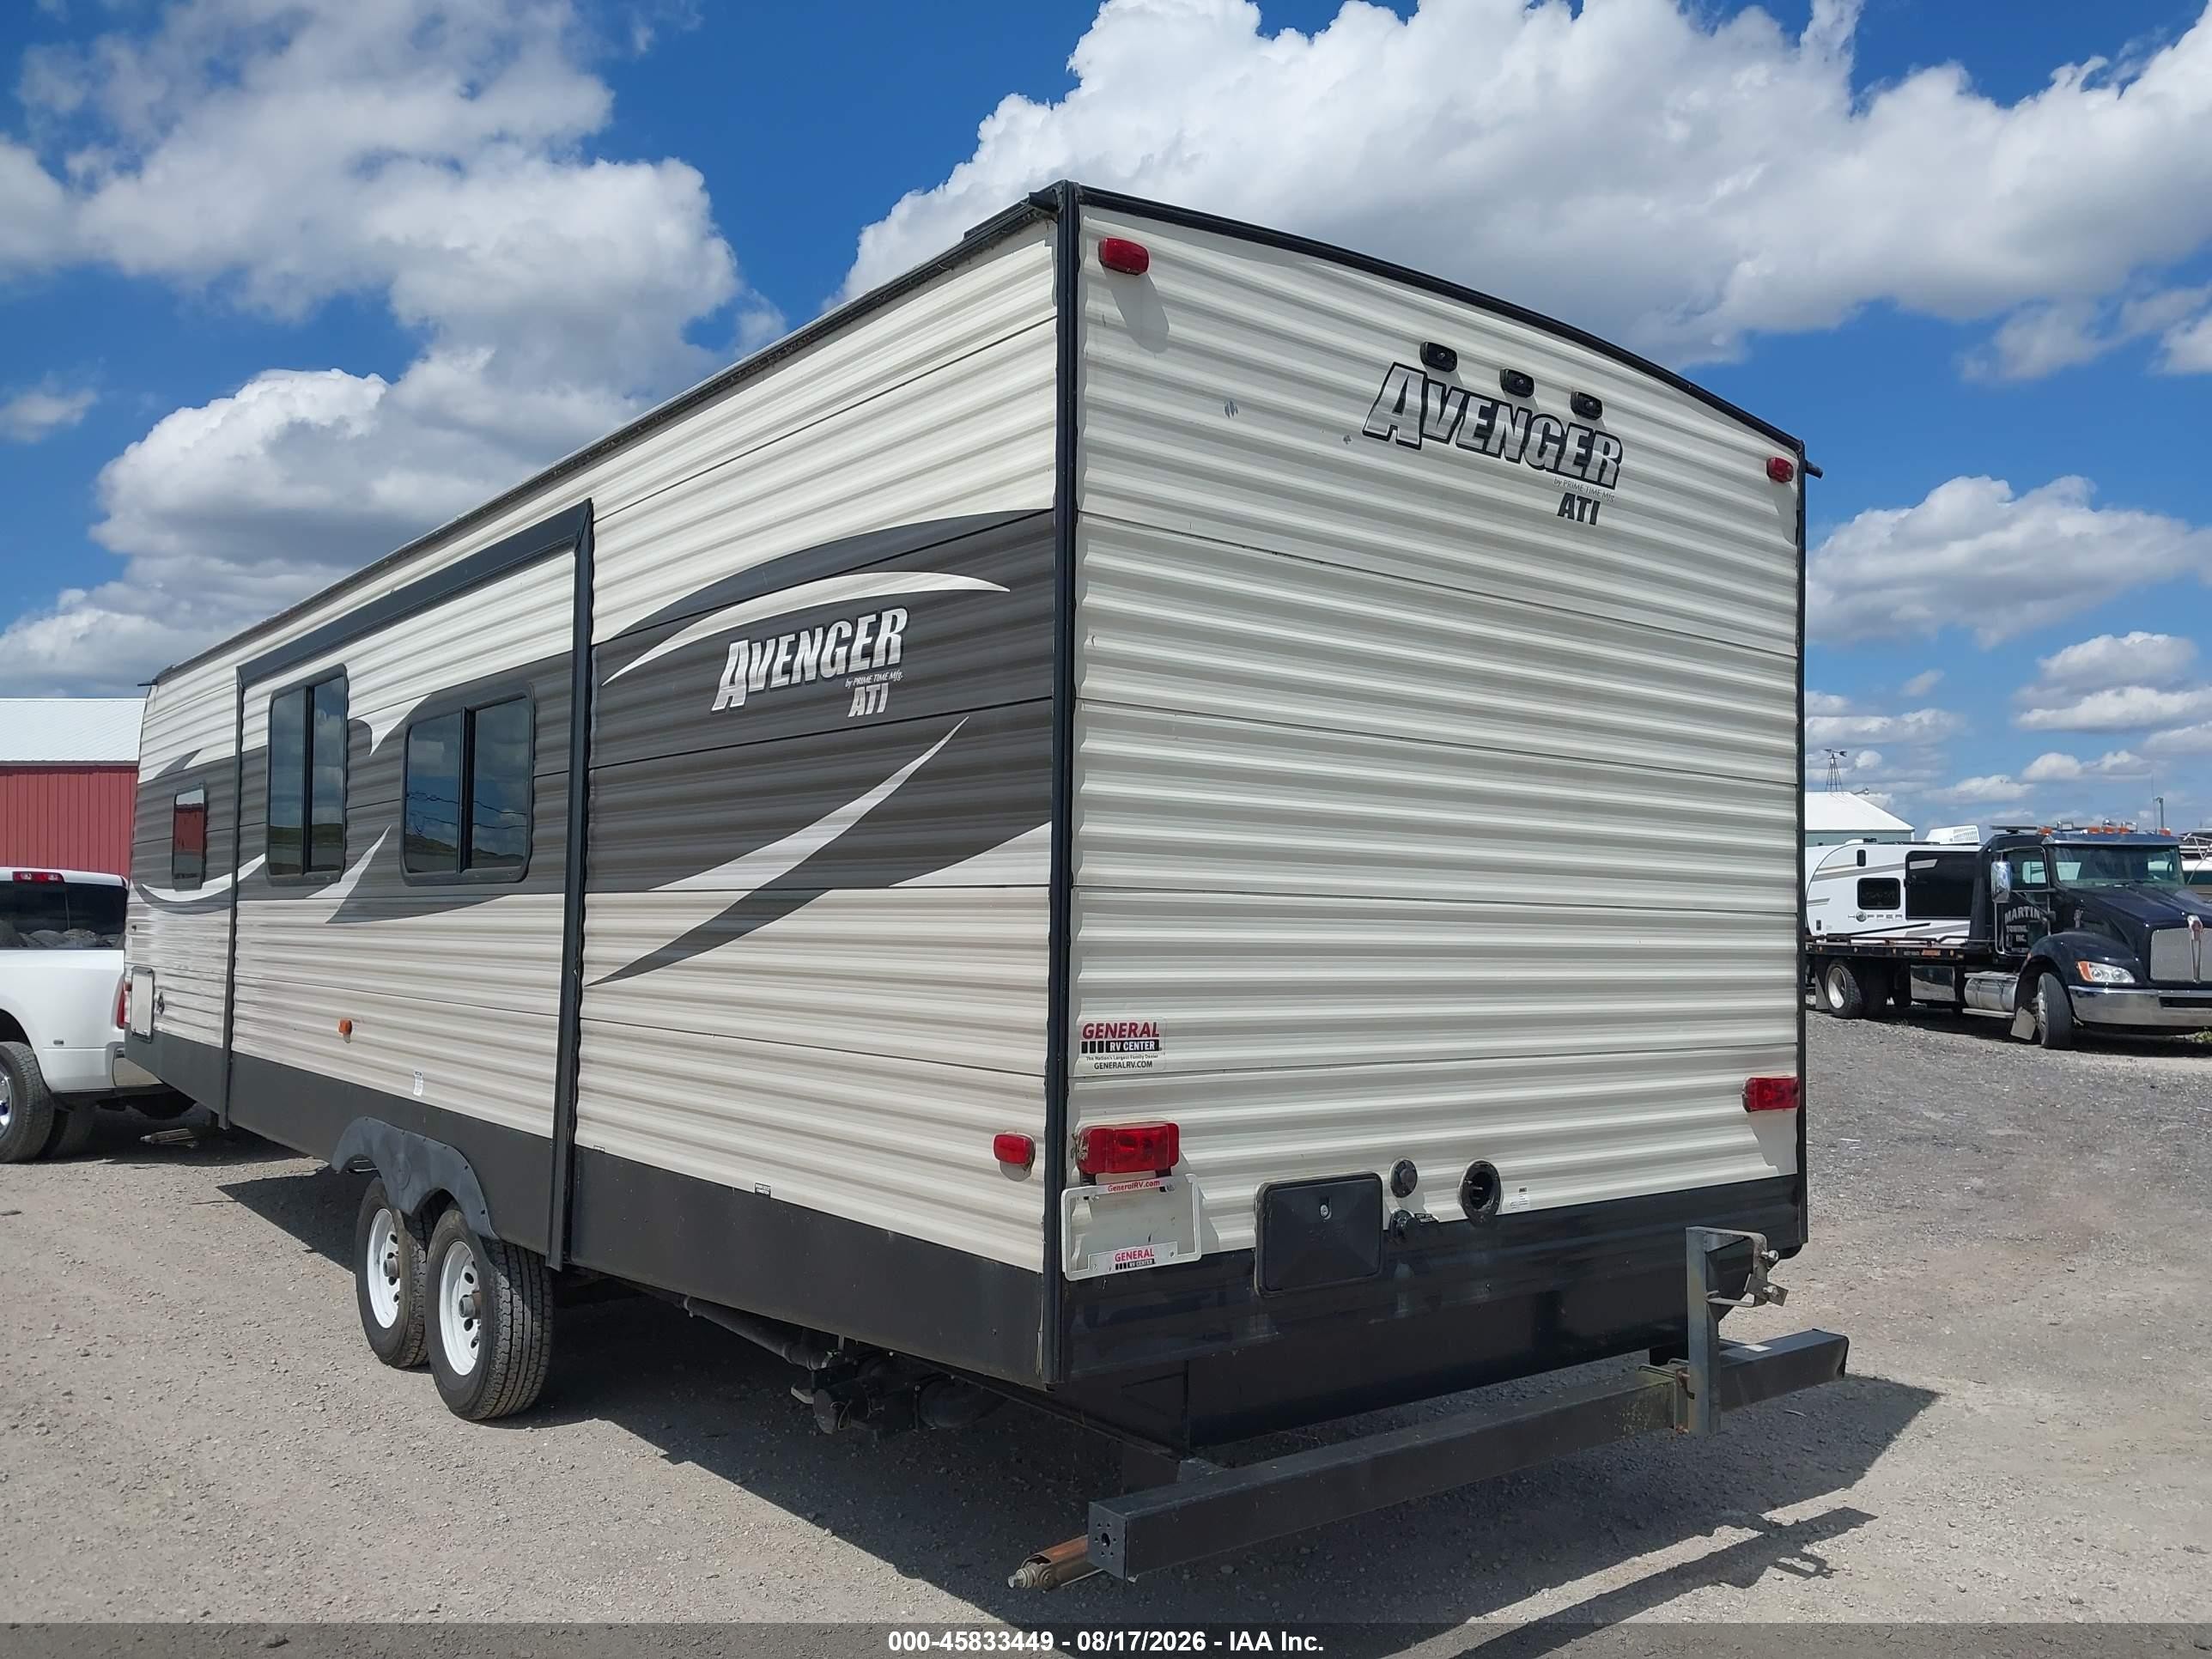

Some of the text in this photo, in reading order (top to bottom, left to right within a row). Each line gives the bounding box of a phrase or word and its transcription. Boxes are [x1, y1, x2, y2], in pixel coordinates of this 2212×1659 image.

[1362, 362, 1623, 490] AVENGER
[1553, 477, 1563, 488] by
[1563, 480, 1585, 492] PRIME
[1585, 486, 1601, 496] TIME
[1557, 492, 1601, 526] ATI
[710, 606, 909, 713] AVENGER
[845, 678, 854, 689] by
[854, 674, 873, 686] PRIME
[873, 672, 890, 683] TIME
[848, 683, 889, 718] ATI
[1083, 1022, 1159, 1039] GENERAL
[1109, 1041, 1155, 1052] RV CENTER
[1094, 1060, 1152, 1070] GENERALRV.COM
[1108, 1180, 1160, 1192] GeneralRV.com
[1115, 1248, 1155, 1262] GENERAL
